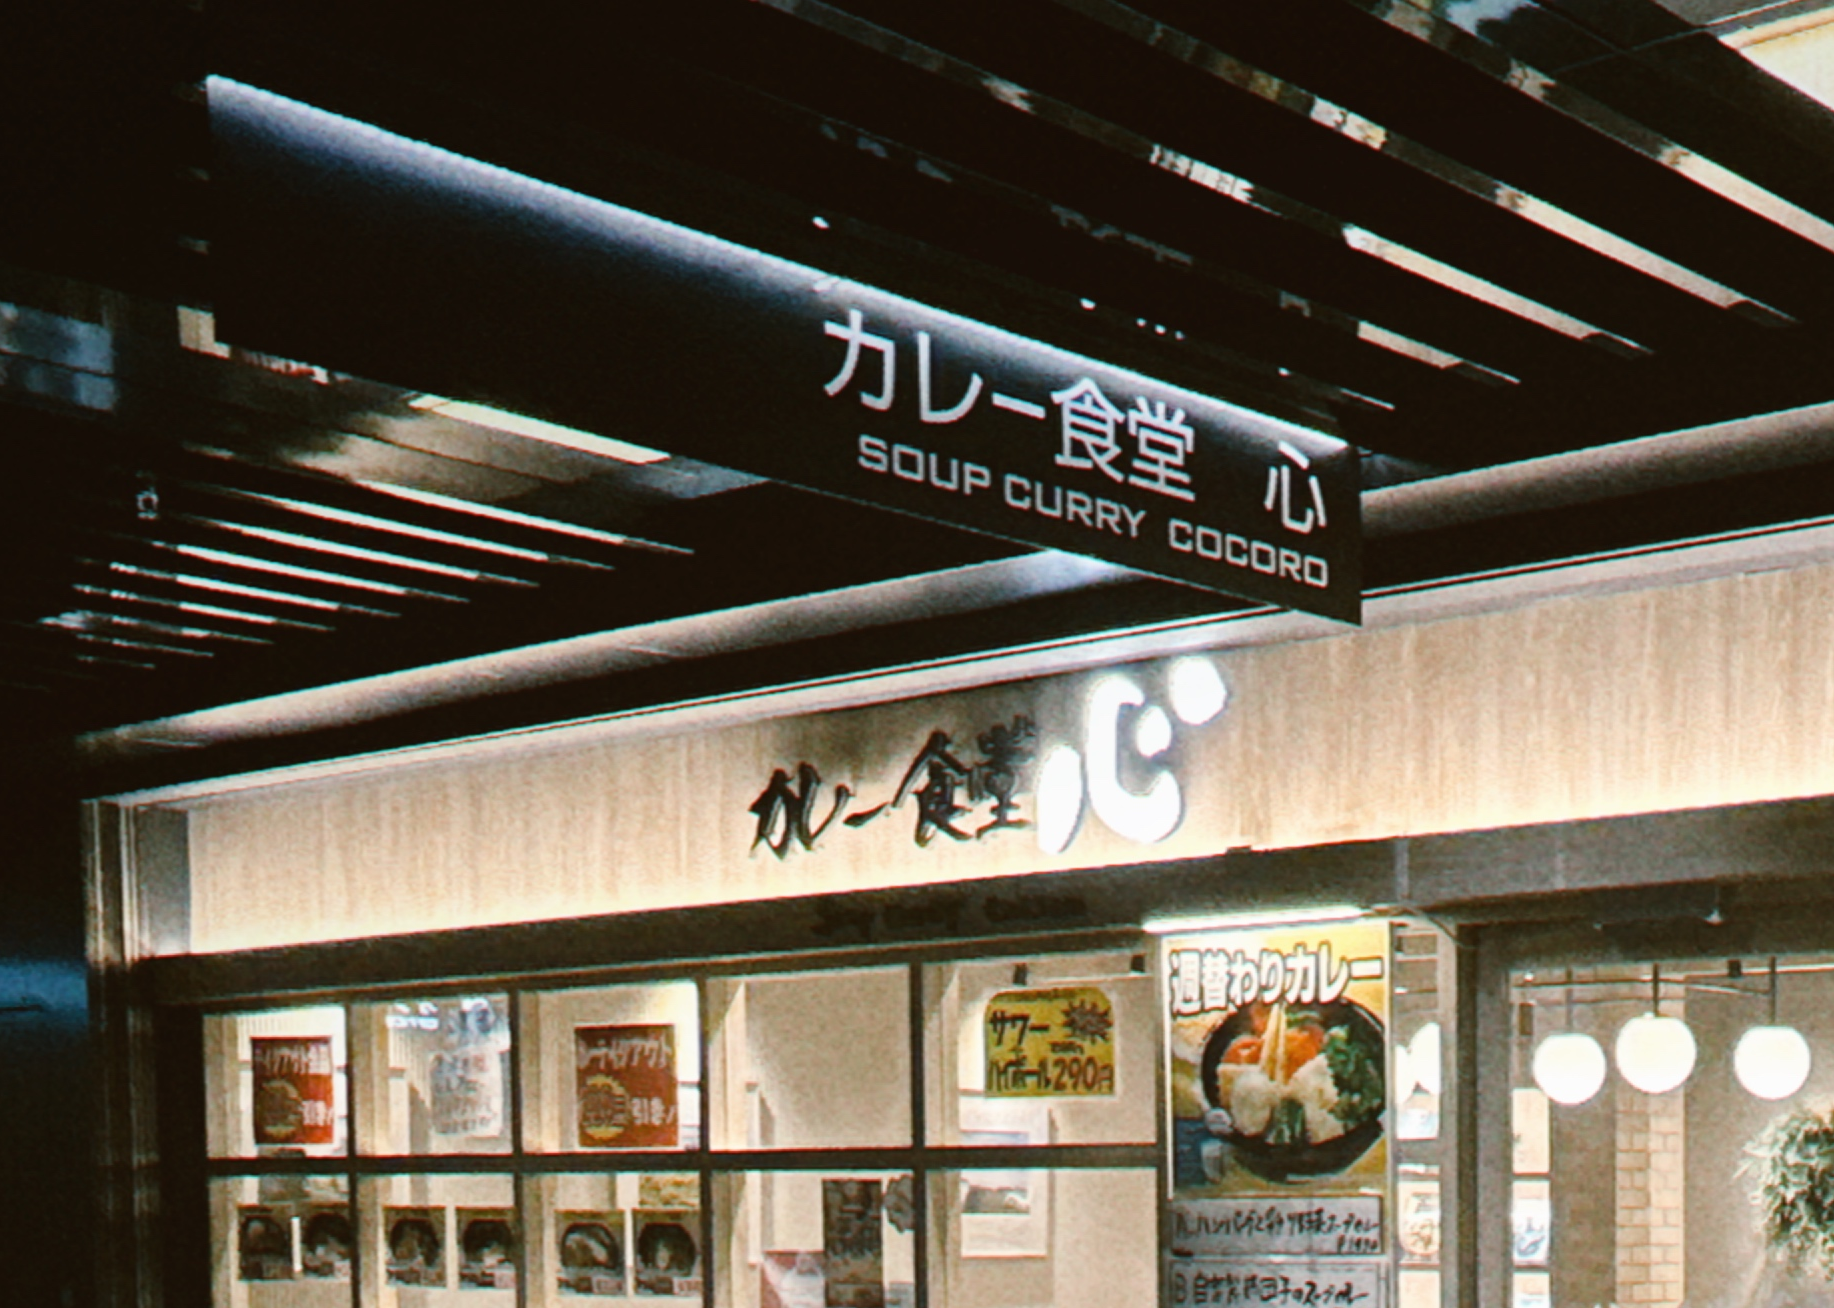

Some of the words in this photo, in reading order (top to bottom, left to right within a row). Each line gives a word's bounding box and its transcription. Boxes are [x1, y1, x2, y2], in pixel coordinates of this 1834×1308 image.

[823, 309, 1197, 503] カレー食堂
[1263, 440, 1326, 535] 心
[857, 435, 990, 497] SOUP
[1003, 473, 1148, 539] CURRY
[1168, 520, 1329, 589] COCORO
[749, 715, 1038, 860] カレー食堂
[1036, 655, 1230, 856] 心
[989, 1010, 1050, 1046] サワー
[1169, 939, 1384, 1017] 週替わりカレー
